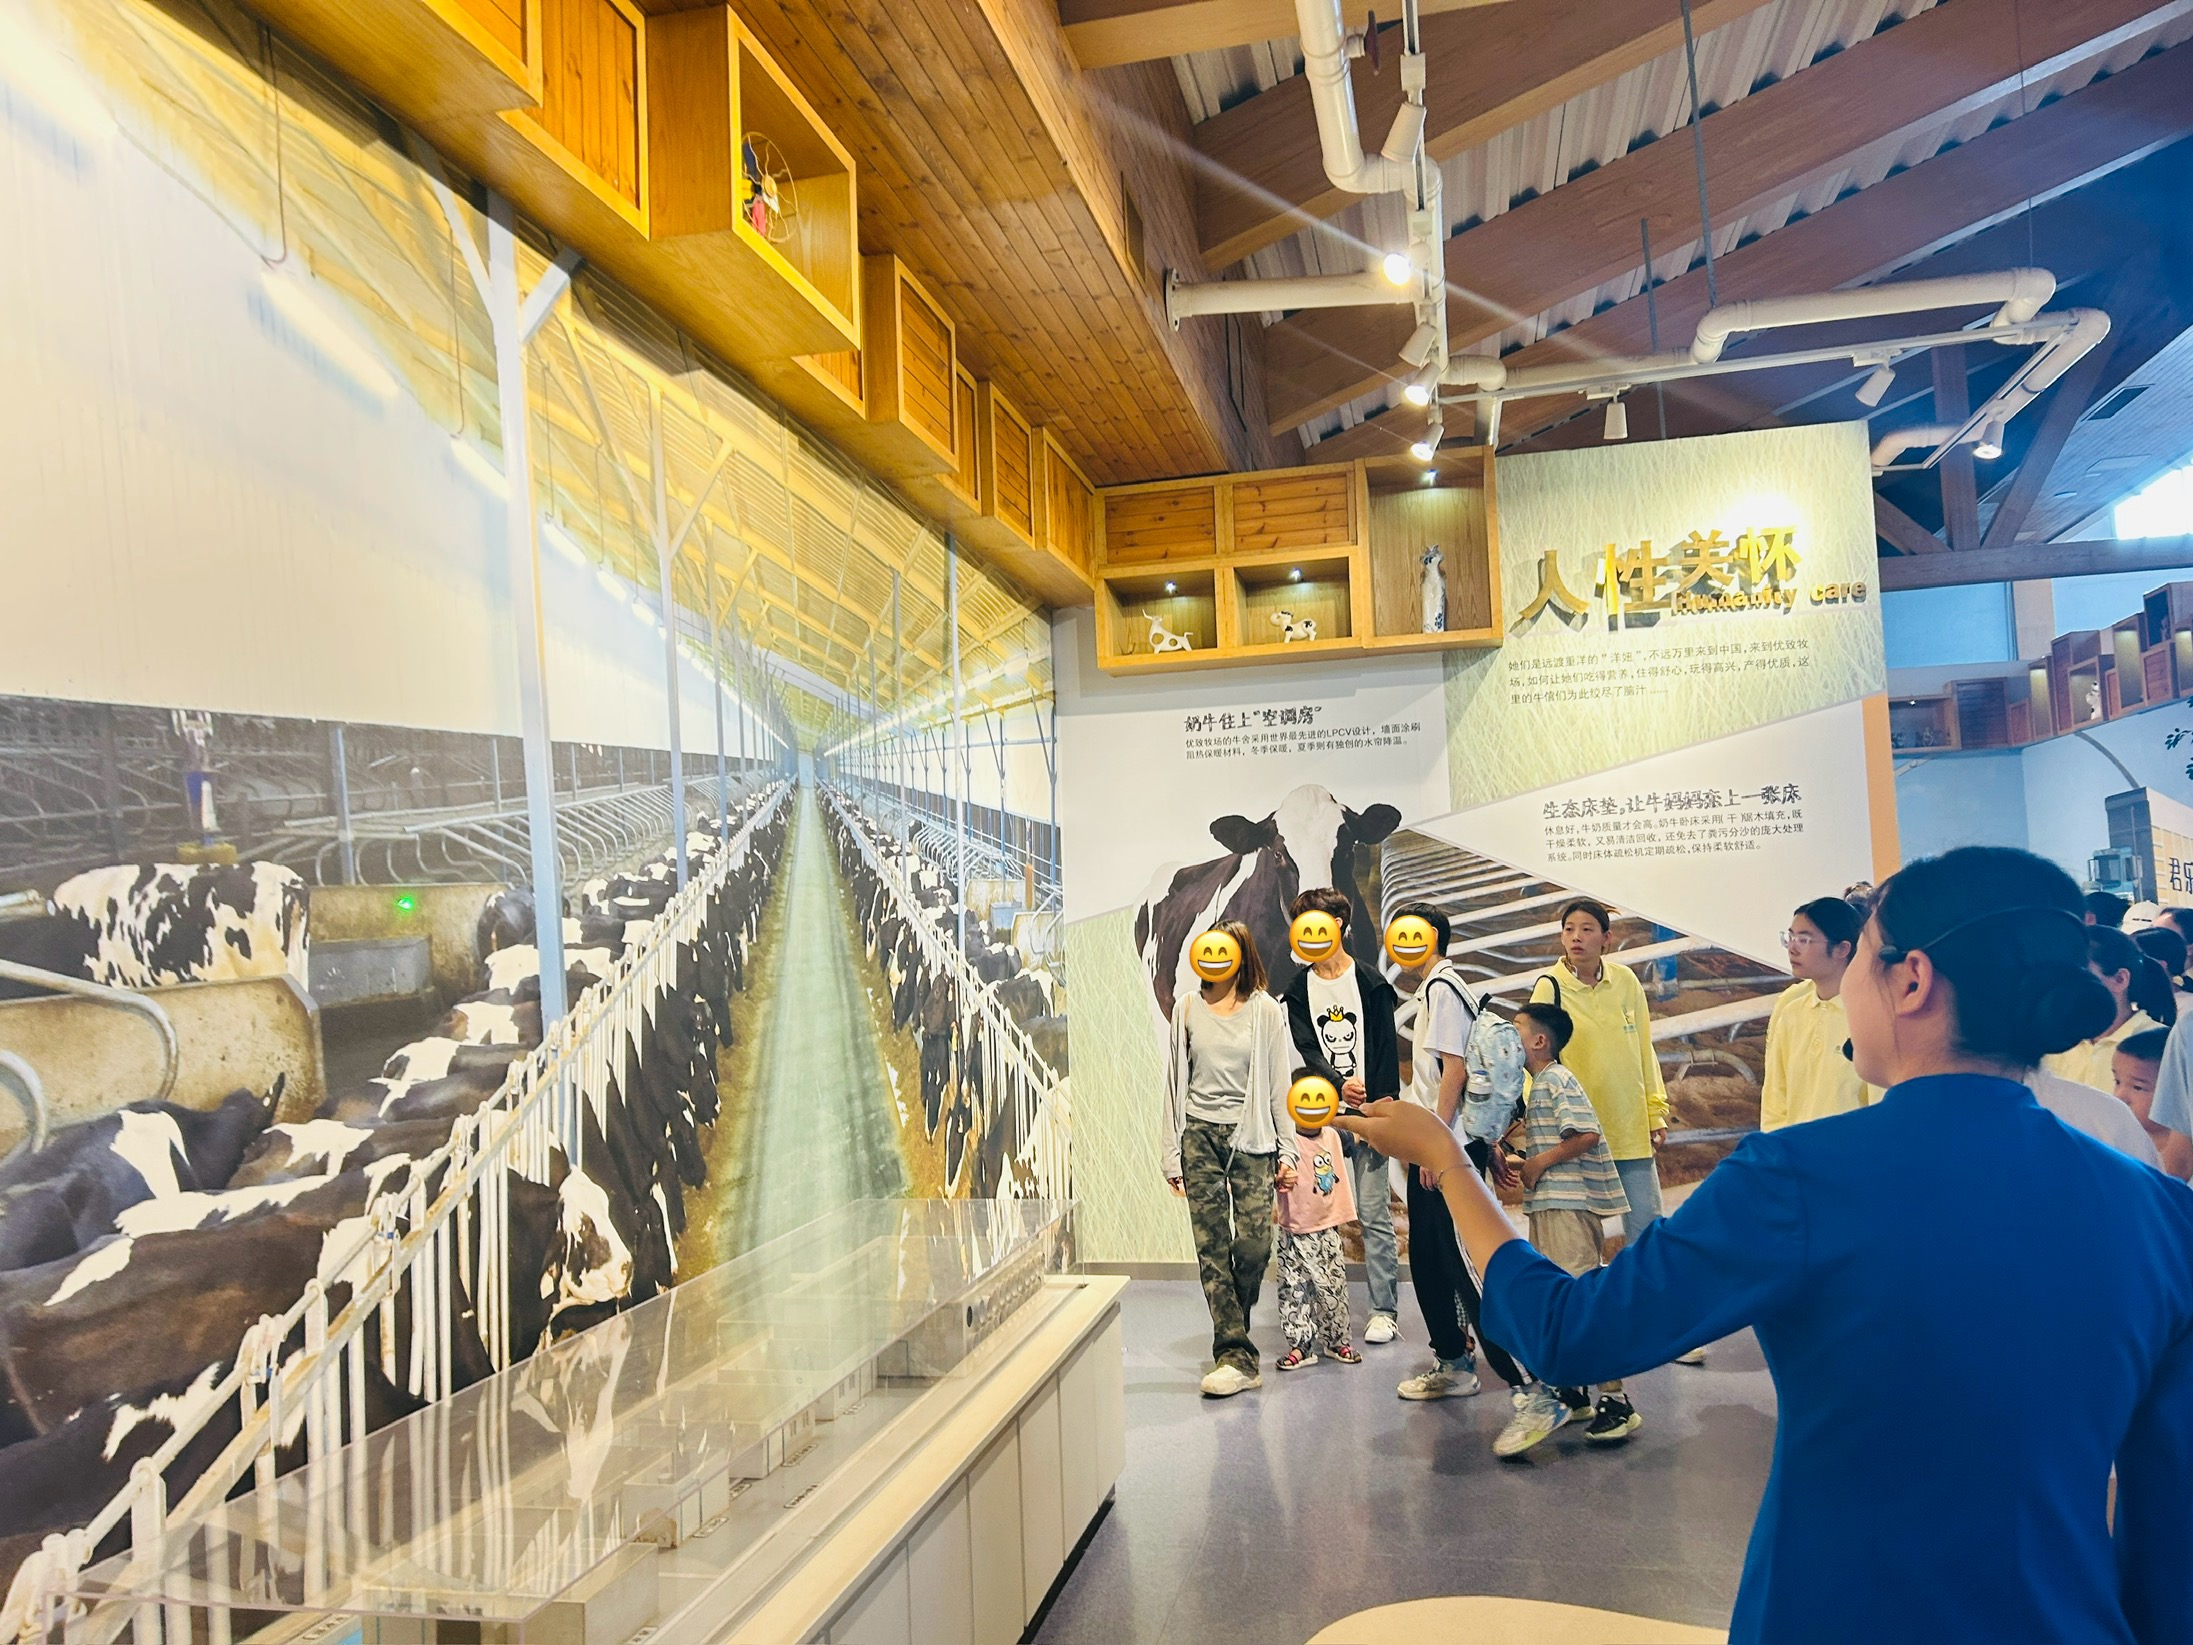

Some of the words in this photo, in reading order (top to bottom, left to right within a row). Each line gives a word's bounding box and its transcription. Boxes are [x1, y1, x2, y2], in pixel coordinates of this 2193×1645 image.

[1517, 525, 1802, 621] 人性关怀
[1673, 584, 1798, 613] Humanity
[1809, 581, 1867, 605] care
